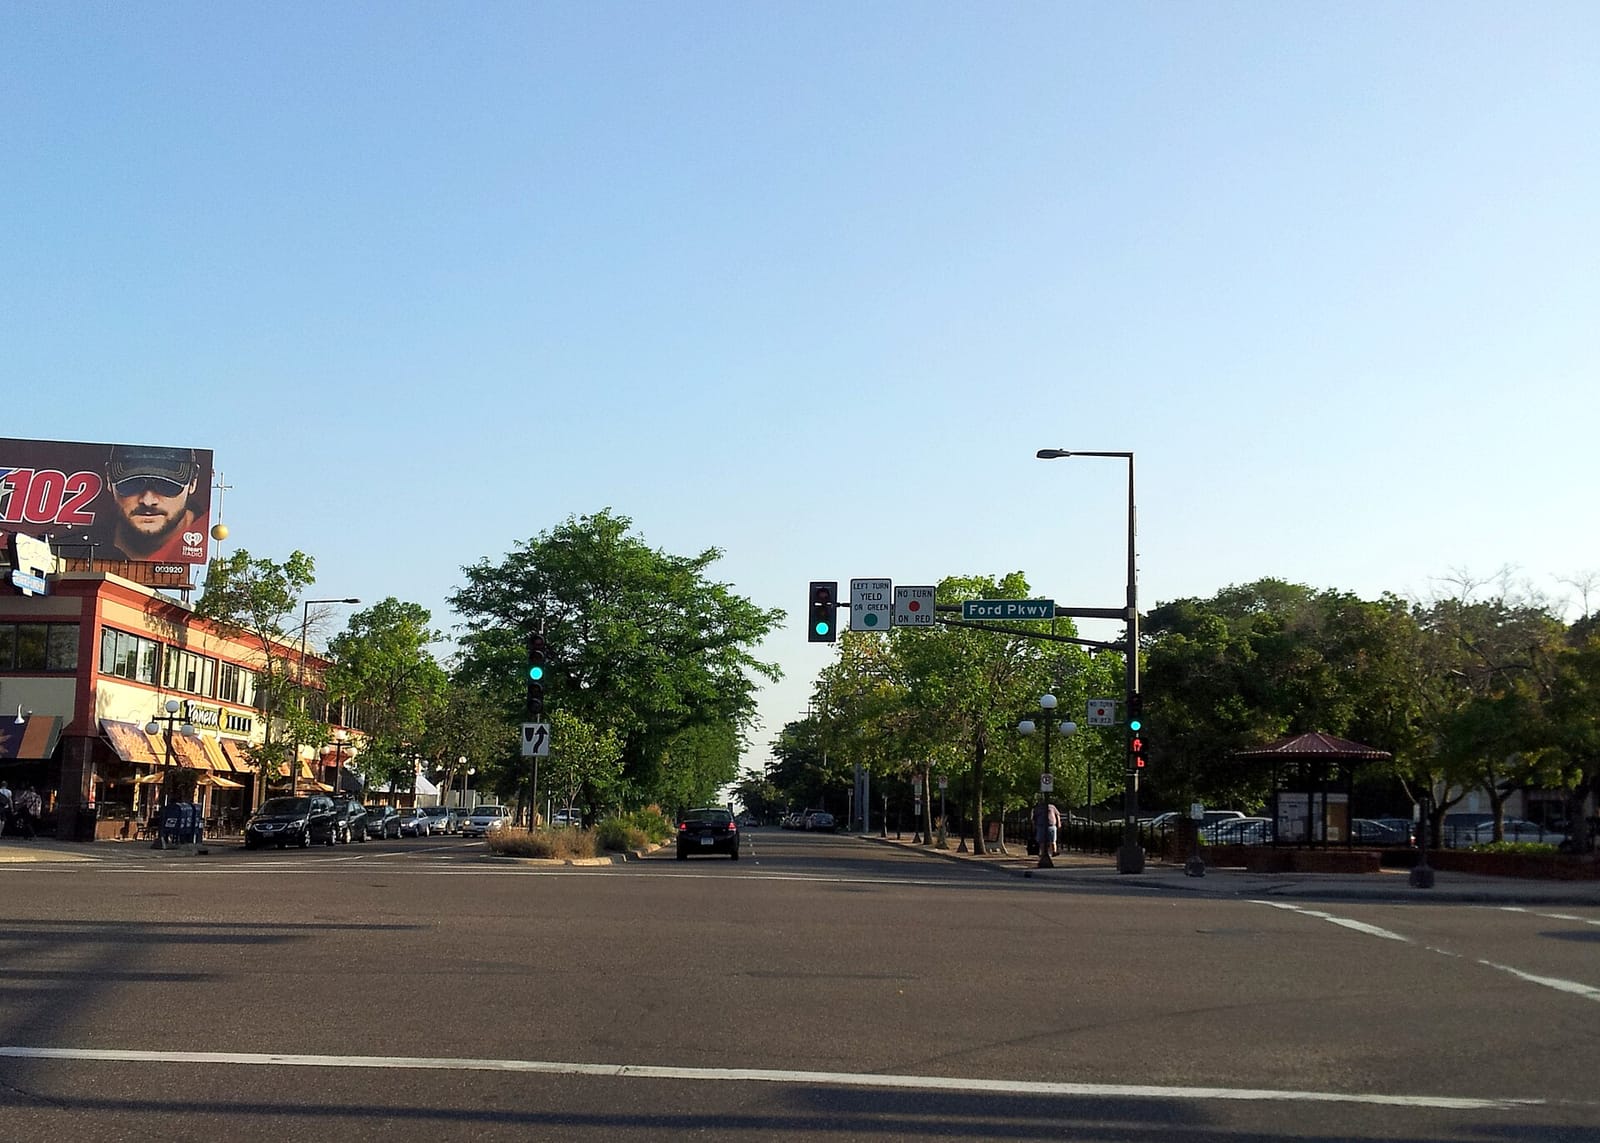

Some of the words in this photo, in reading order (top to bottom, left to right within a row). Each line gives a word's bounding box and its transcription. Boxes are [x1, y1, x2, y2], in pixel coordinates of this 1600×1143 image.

[853, 582, 868, 590] LEFT
[872, 582, 889, 590] TURN
[860, 592, 883, 601] YIELD
[897, 589, 908, 598] NO
[912, 589, 933, 598] TURN
[867, 603, 889, 611] GREEN
[969, 604, 1002, 615] Ford
[1007, 604, 1048, 617] Pkwy
[898, 614, 909, 623] ON
[915, 614, 931, 623] RED
[186, 699, 218, 727] Panera
